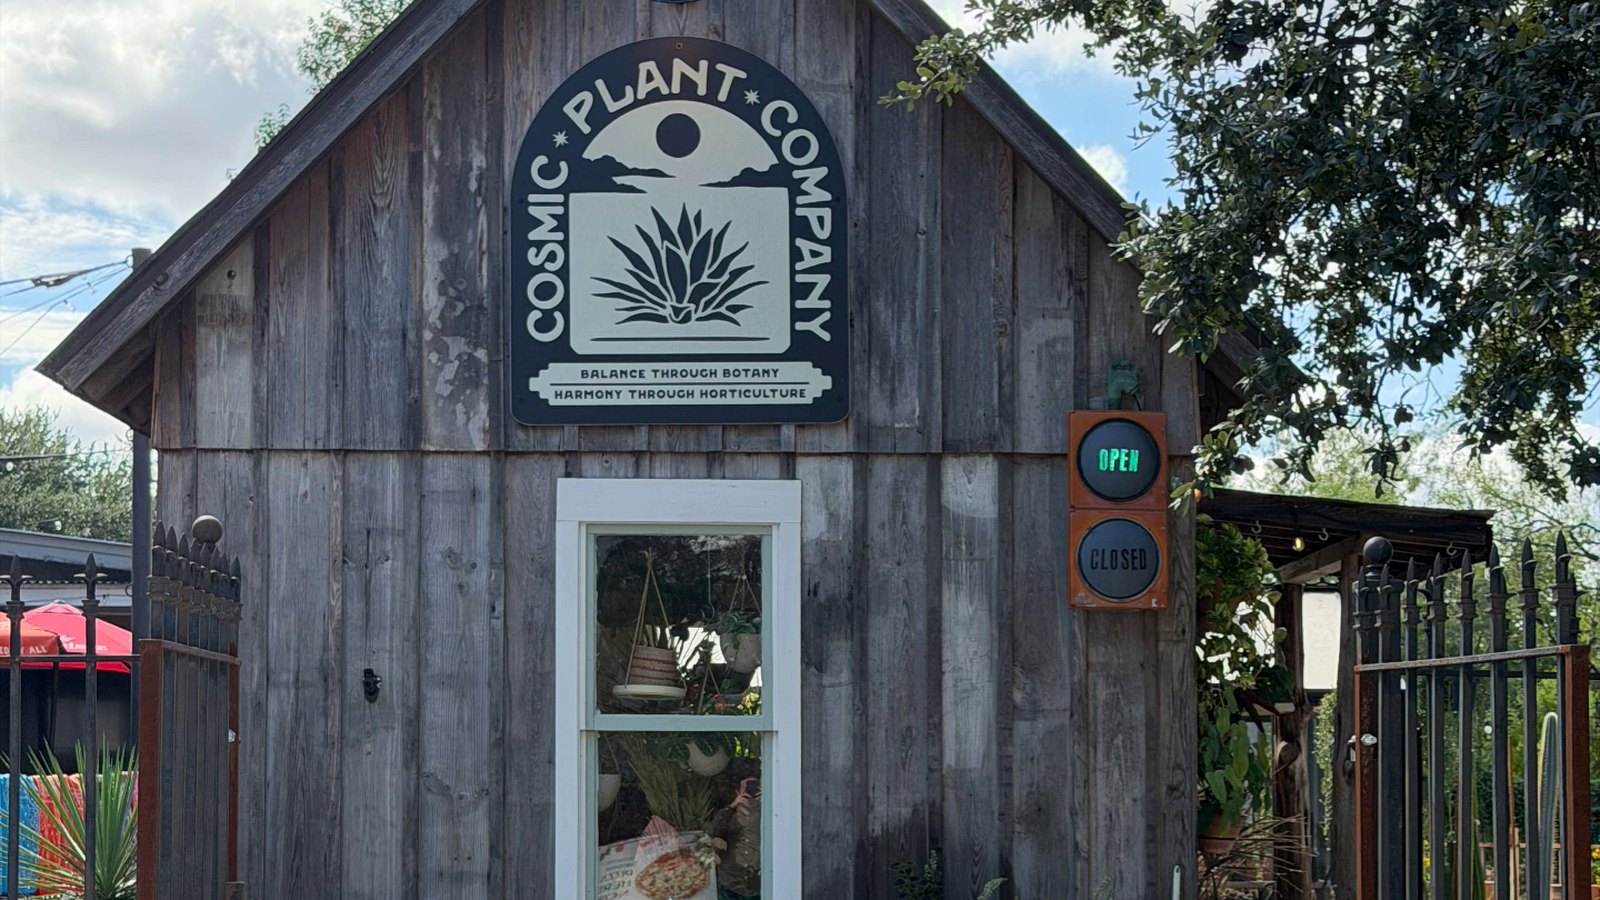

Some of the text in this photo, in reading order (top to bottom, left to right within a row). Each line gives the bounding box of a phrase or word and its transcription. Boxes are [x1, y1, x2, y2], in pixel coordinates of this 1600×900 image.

[526, 57, 833, 343] COSMIC PLANT COMPANY
[580, 368, 780, 379] BALANCE THROUGH BOTANY
[554, 388, 807, 400] HARMONY THROUGH HORTICULTURE
[1098, 449, 1139, 472] OPEN
[1091, 549, 1147, 570] CLOSED
[29, 645, 48, 654] ALL
